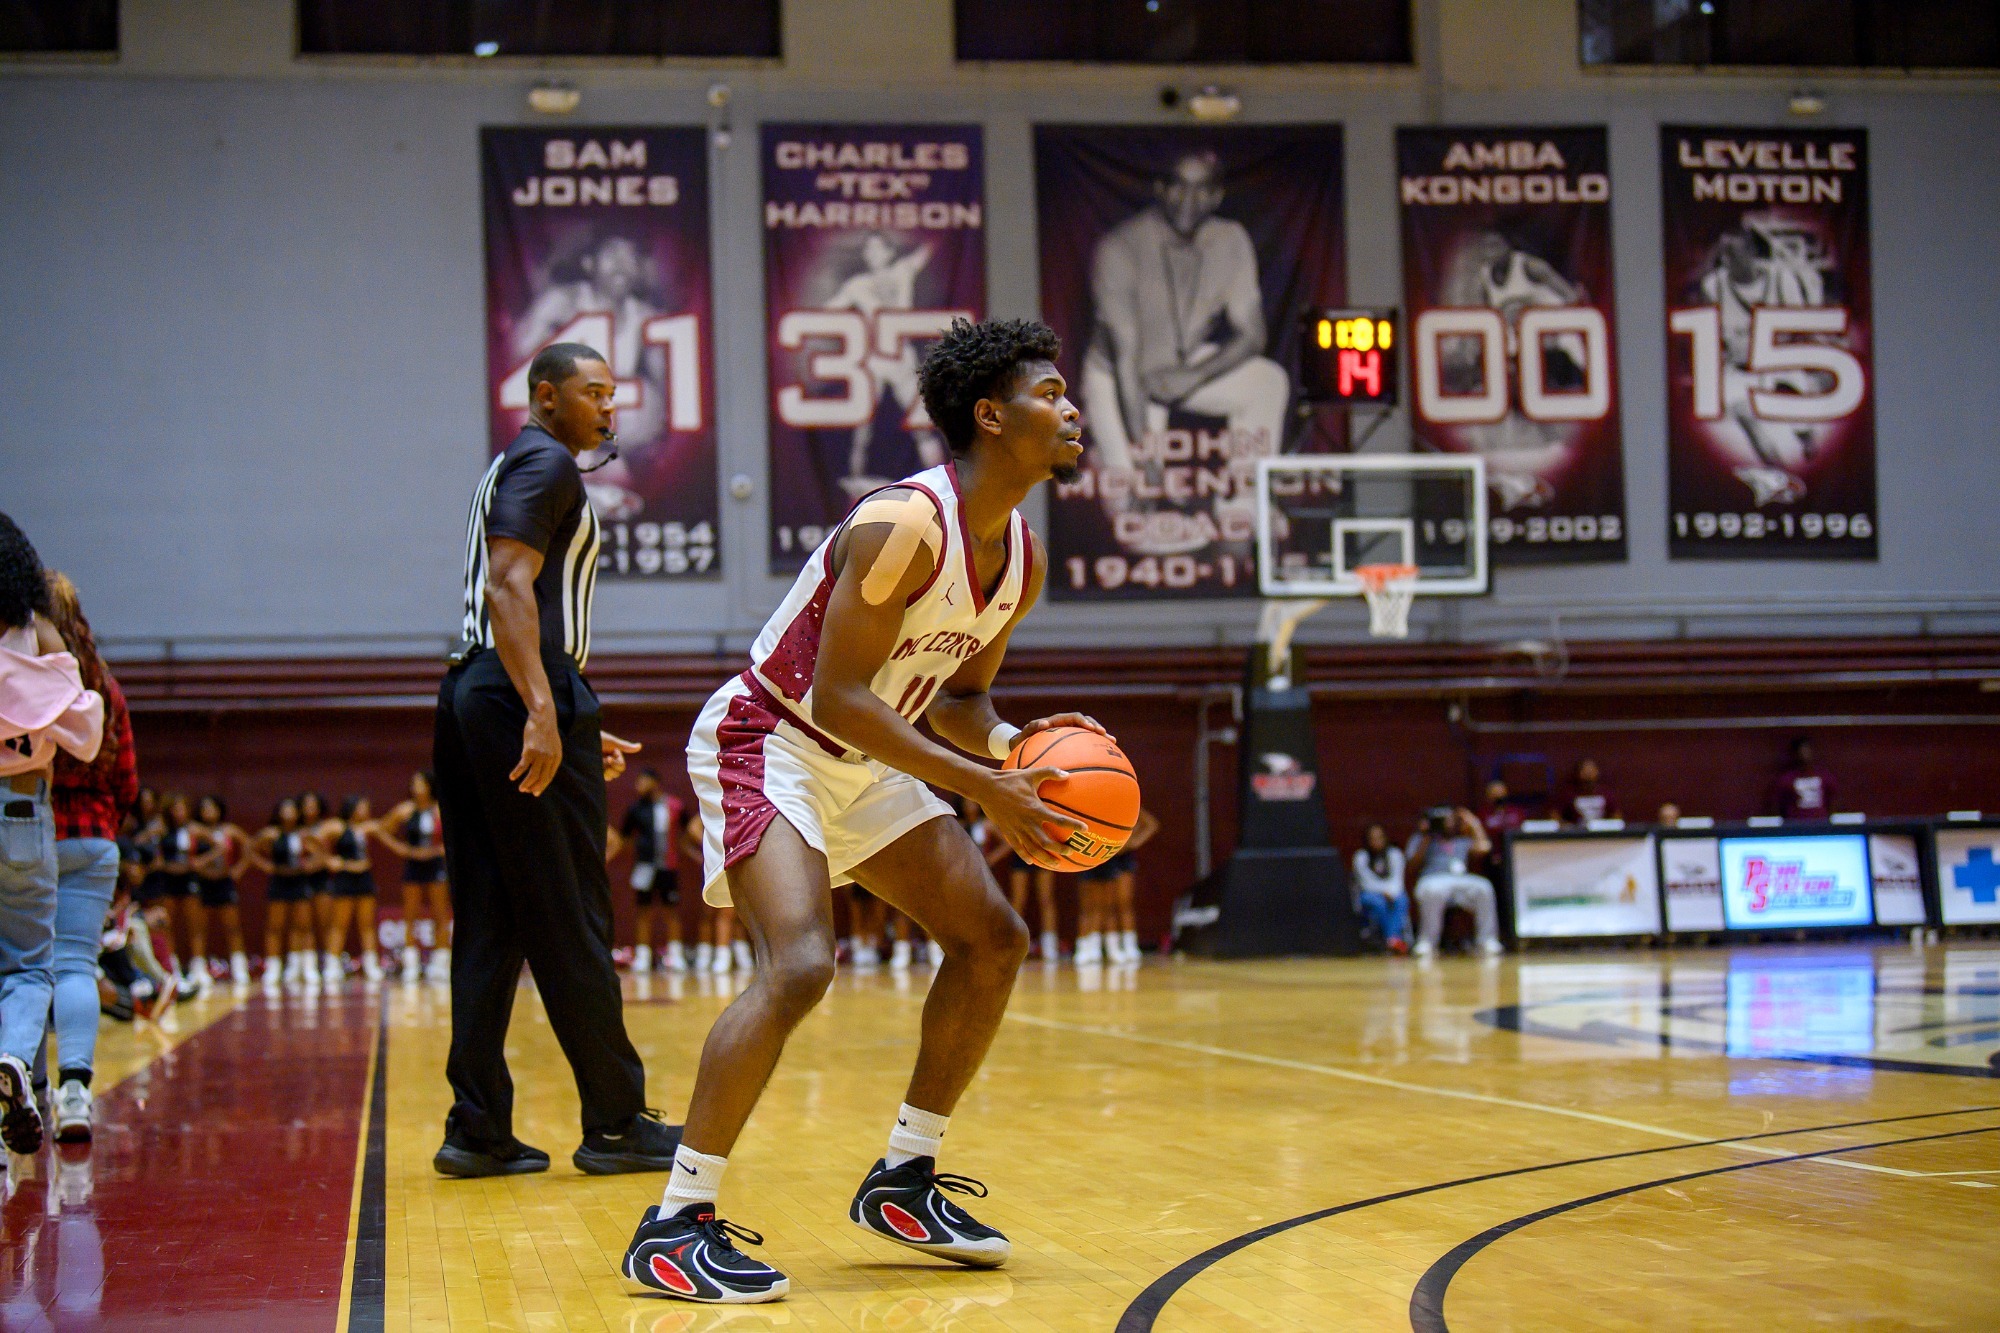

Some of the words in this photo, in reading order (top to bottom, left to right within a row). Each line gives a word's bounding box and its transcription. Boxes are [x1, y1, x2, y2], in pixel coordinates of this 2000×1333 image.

[545, 141, 647, 168] SAM
[776, 142, 969, 170] CHARLES
[1443, 141, 1565, 169] AMBA
[1679, 140, 1855, 170] LEVELLE
[512, 177, 679, 206] JONES
[1401, 175, 1609, 204] KONGOLO
[1693, 175, 1842, 201] MOTON
[766, 202, 981, 229] HARRISON
[500, 312, 702, 432] 41
[1338, 349, 1381, 397] 14
[1415, 305, 1610, 424] 00
[1669, 306, 1866, 423] 15
[1130, 428, 1271, 461] JOHN
[598, 522, 714, 547] -1954
[1673, 512, 1873, 540] 1992-1996
[598, 548, 715, 575] -1957
[890, 633, 931, 660] NC
[923, 631, 984, 659] CENTR
[895, 673, 937, 720] 11
